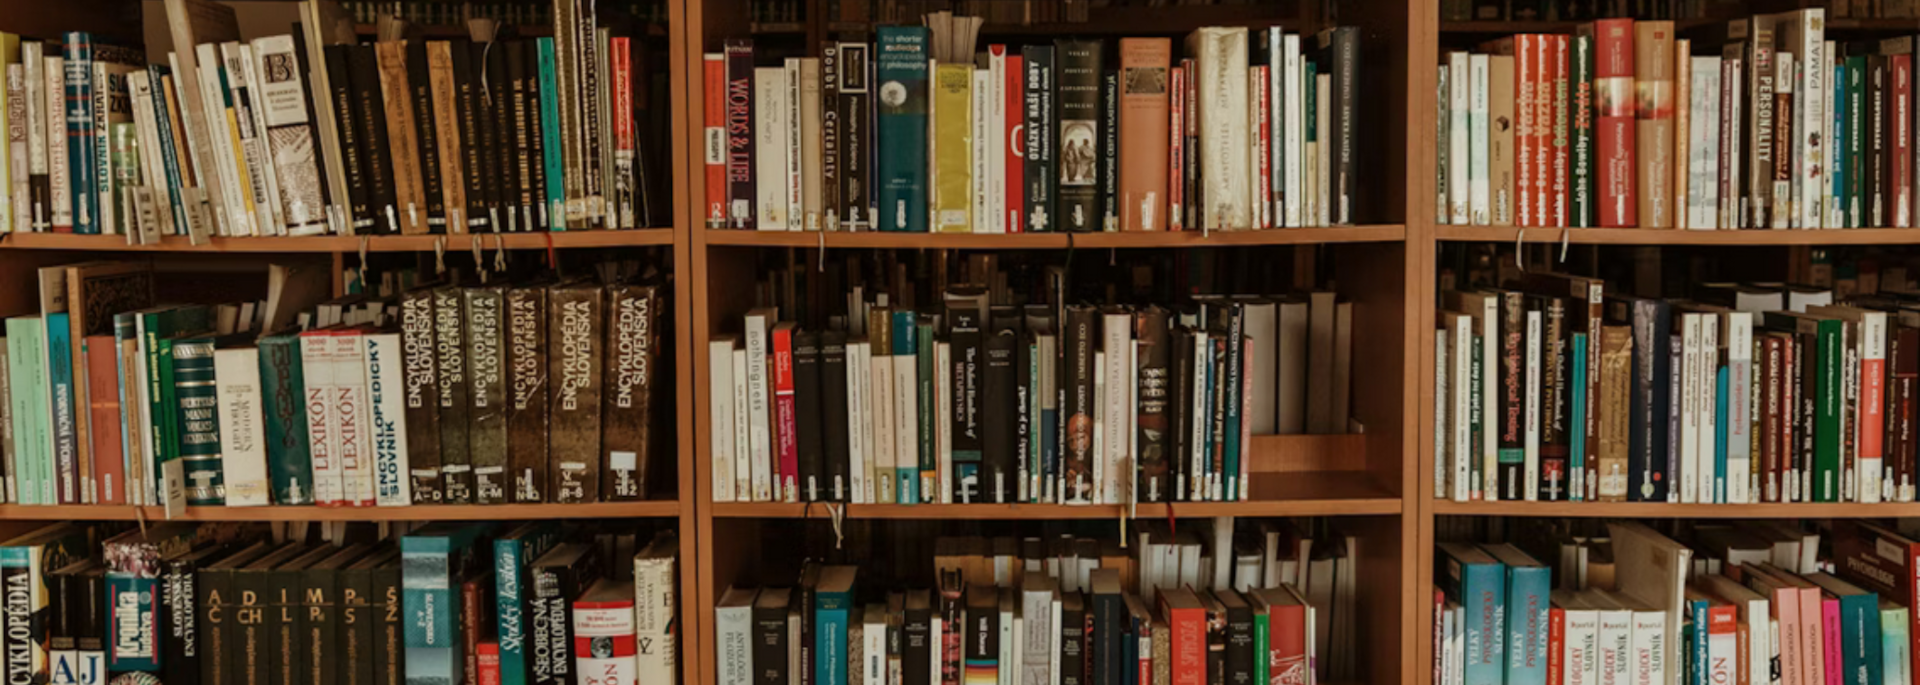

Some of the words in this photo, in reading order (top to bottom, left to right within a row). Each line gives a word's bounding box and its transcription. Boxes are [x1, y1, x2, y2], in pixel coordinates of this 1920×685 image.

[896, 35, 922, 43] shorter
[824, 48, 836, 90] Doubt
[887, 61, 928, 72] philosophy
[1028, 61, 1040, 89] DOBY
[1342, 60, 1351, 100] UMBERTO
[728, 78, 749, 135] WORDS
[849, 96, 858, 133] Philosophy
[1027, 92, 1040, 118] NAŠÍ
[1516, 81, 1533, 136] Vazba
[1533, 82, 1550, 136] Vazba
[1759, 76, 1773, 162] PERSONALITY
[1851, 93, 1859, 152] PSYCHOLOGIE
[1873, 91, 1882, 150] PSYCHOLOGIE
[1897, 94, 1906, 148] PSYCHOLOGIE
[731, 136, 749, 149] &
[824, 111, 837, 179] Certainty
[850, 143, 858, 171] Science
[1027, 121, 1040, 160] OTÁZKY
[1106, 134, 1115, 156] CESTY
[1576, 135, 1589, 175] Bowlby
[51, 140, 65, 202] Slovník
[97, 135, 108, 193] SLOVNÍK
[729, 152, 749, 182] LIFE
[1106, 157, 1115, 194] EVROPSKÉ
[1518, 145, 1531, 186] Bowlby
[1536, 146, 1549, 187] Bowlby
[1553, 151, 1566, 191] Bowlby
[148, 332, 159, 352] public
[417, 298, 435, 385] SLOVENSKA
[448, 297, 462, 383] SLOVENSKA
[485, 297, 498, 383] SLOVENSKA
[524, 300, 537, 386] SLOVENSKA
[578, 300, 591, 388] SLOVENSKA
[633, 297, 648, 385] SLOVENSKA
[1078, 323, 1086, 341] ECO
[1556, 340, 1566, 354] The
[149, 354, 160, 380] internet
[401, 299, 422, 408] ENCYKLOPÉDIA
[435, 298, 452, 408] ENCYKLOPÉDIA
[473, 297, 488, 408] ENCYKLOPÉDIA
[512, 300, 527, 410] ENCYKLOPÉDIA
[561, 301, 578, 411] ENCYKLOPÉDIA
[617, 297, 635, 408] ENCYKLOPÉDIA
[749, 331, 762, 411] nothingness
[967, 347, 976, 362] The
[1077, 342, 1086, 380] UMBERTO
[1505, 332, 1520, 402] Psychological
[1555, 355, 1565, 380] Oxford
[1770, 349, 1780, 377] FREUD
[956, 361, 965, 422] METAPHYSICS
[967, 363, 976, 389] Oxford
[1845, 348, 1856, 400] psychologie
[57, 383, 72, 437] INFORMAČNÁ
[967, 390, 976, 428] Handbook
[1544, 388, 1553, 442] PSYCHOLOGY
[1554, 381, 1564, 420] Handbook
[1769, 379, 1779, 415] SIGMUND
[241, 399, 254, 452] MODERN
[306, 387, 329, 471] LEXIKÓN
[336, 387, 359, 471] LEXIKÓN
[367, 339, 389, 497] ENCYKLOPEDICKÝ
[1504, 403, 1520, 442] Testing
[384, 421, 399, 497] SLOVNÍK
[162, 573, 172, 606] MALÁ
[173, 572, 183, 637] SLOVENSKÁ
[208, 589, 222, 604] A
[243, 590, 257, 605] D
[281, 588, 287, 604] I
[307, 588, 324, 603] M
[386, 586, 397, 604] Š
[115, 590, 139, 658] Kronika
[183, 572, 195, 657] ENCYKLOPÉDIA
[209, 606, 222, 623] Č
[238, 608, 262, 624] CH
[282, 606, 292, 622] L
[344, 608, 355, 624] S
[385, 605, 398, 621] Ž
[979, 616, 987, 630] Will
[1482, 589, 1494, 664] PSYCHOLOGICKÝ
[1494, 604, 1504, 654] SLOVNÍK
[1526, 591, 1538, 668] PSYCHOLOGICKÝ
[1538, 607, 1549, 657] SLOVNÍK
[530, 597, 550, 683] VŠEOBECNÁ
[548, 597, 567, 675] ENCYKLOPÉDIA
[978, 631, 987, 656] Durant
[1468, 627, 1480, 666] VELKÝ
[1511, 630, 1523, 669] VELKÝ
[1584, 633, 1595, 671] SLOVNÍK
[1616, 633, 1627, 672] SLOVNÍK
[1651, 633, 1662, 671] SLOVNÍK
[52, 655, 76, 684] A
[81, 655, 101, 685] J
[737, 631, 746, 684] ANTOLÓGIA
